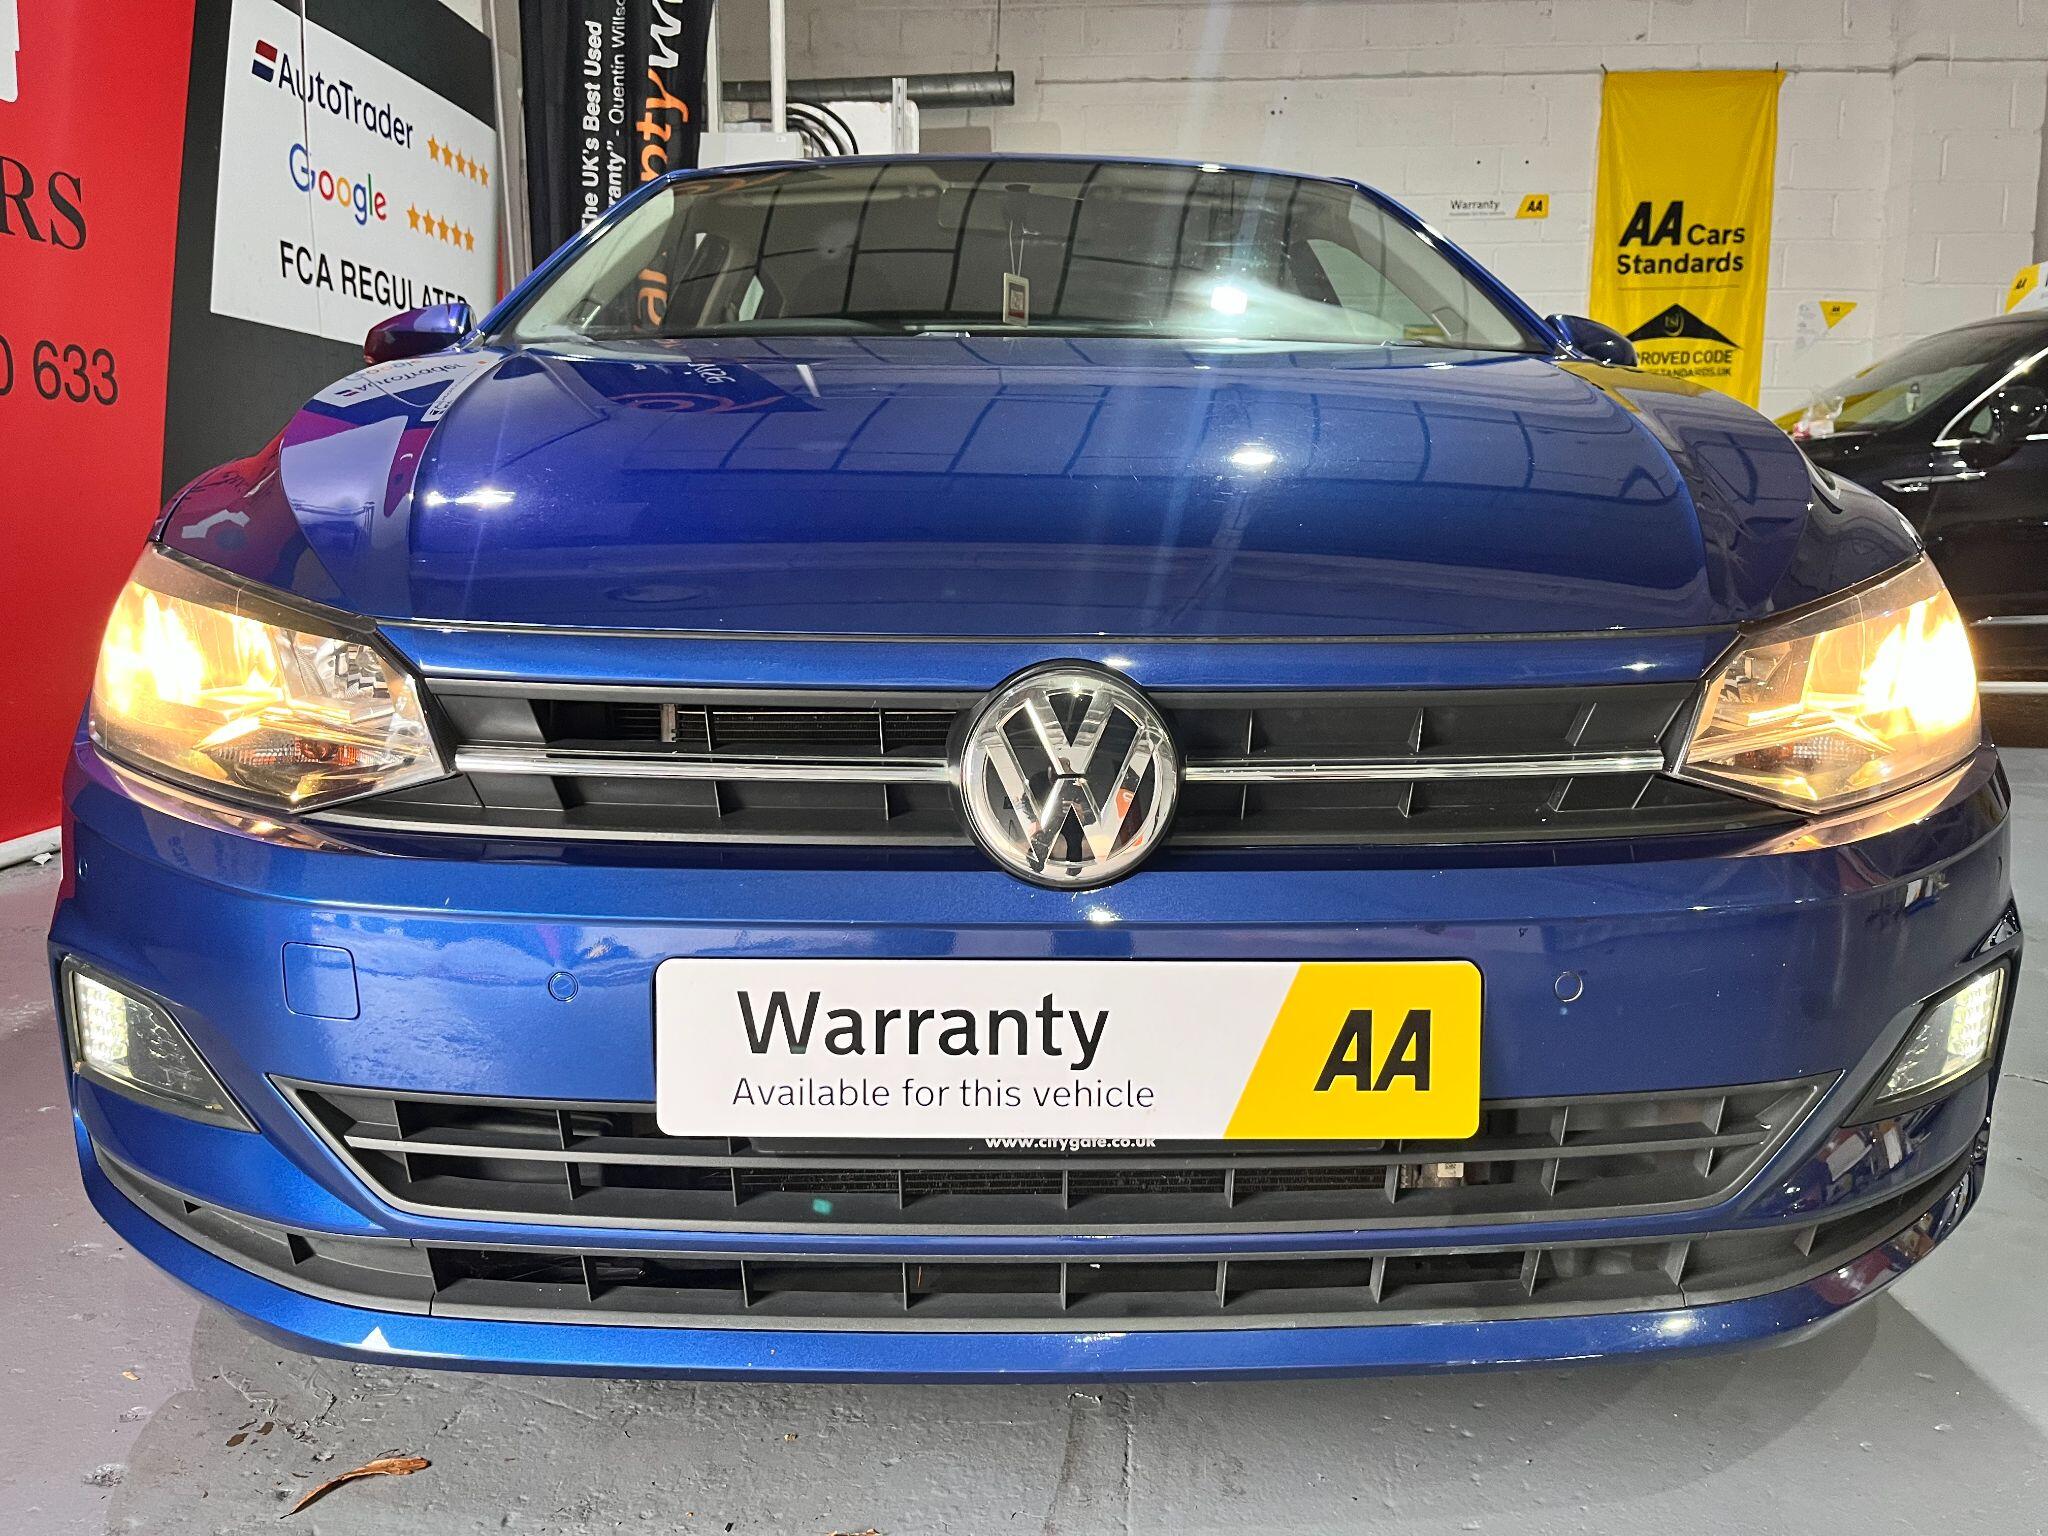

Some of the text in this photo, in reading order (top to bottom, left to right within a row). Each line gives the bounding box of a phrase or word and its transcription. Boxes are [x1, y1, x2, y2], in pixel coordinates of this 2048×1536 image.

[584, 20, 602, 76] Used
[278, 53, 414, 150] AutoTrader
[582, 82, 601, 130] Best
[608, 54, 625, 124] Quentin
[289, 143, 388, 225] Google
[1450, 199, 1500, 212] Warranty
[1526, 199, 1543, 212] AA
[1618, 201, 1746, 247] AA Cars
[280, 240, 334, 292] FCA
[1617, 251, 1745, 275] Standards
[33, 340, 118, 405] 633
[1692, 350, 1733, 365] CODE
[736, 990, 1110, 1071] Warranty
[1313, 1009, 1431, 1092] AA
[732, 1077, 1154, 1108] Available for this vehicle
